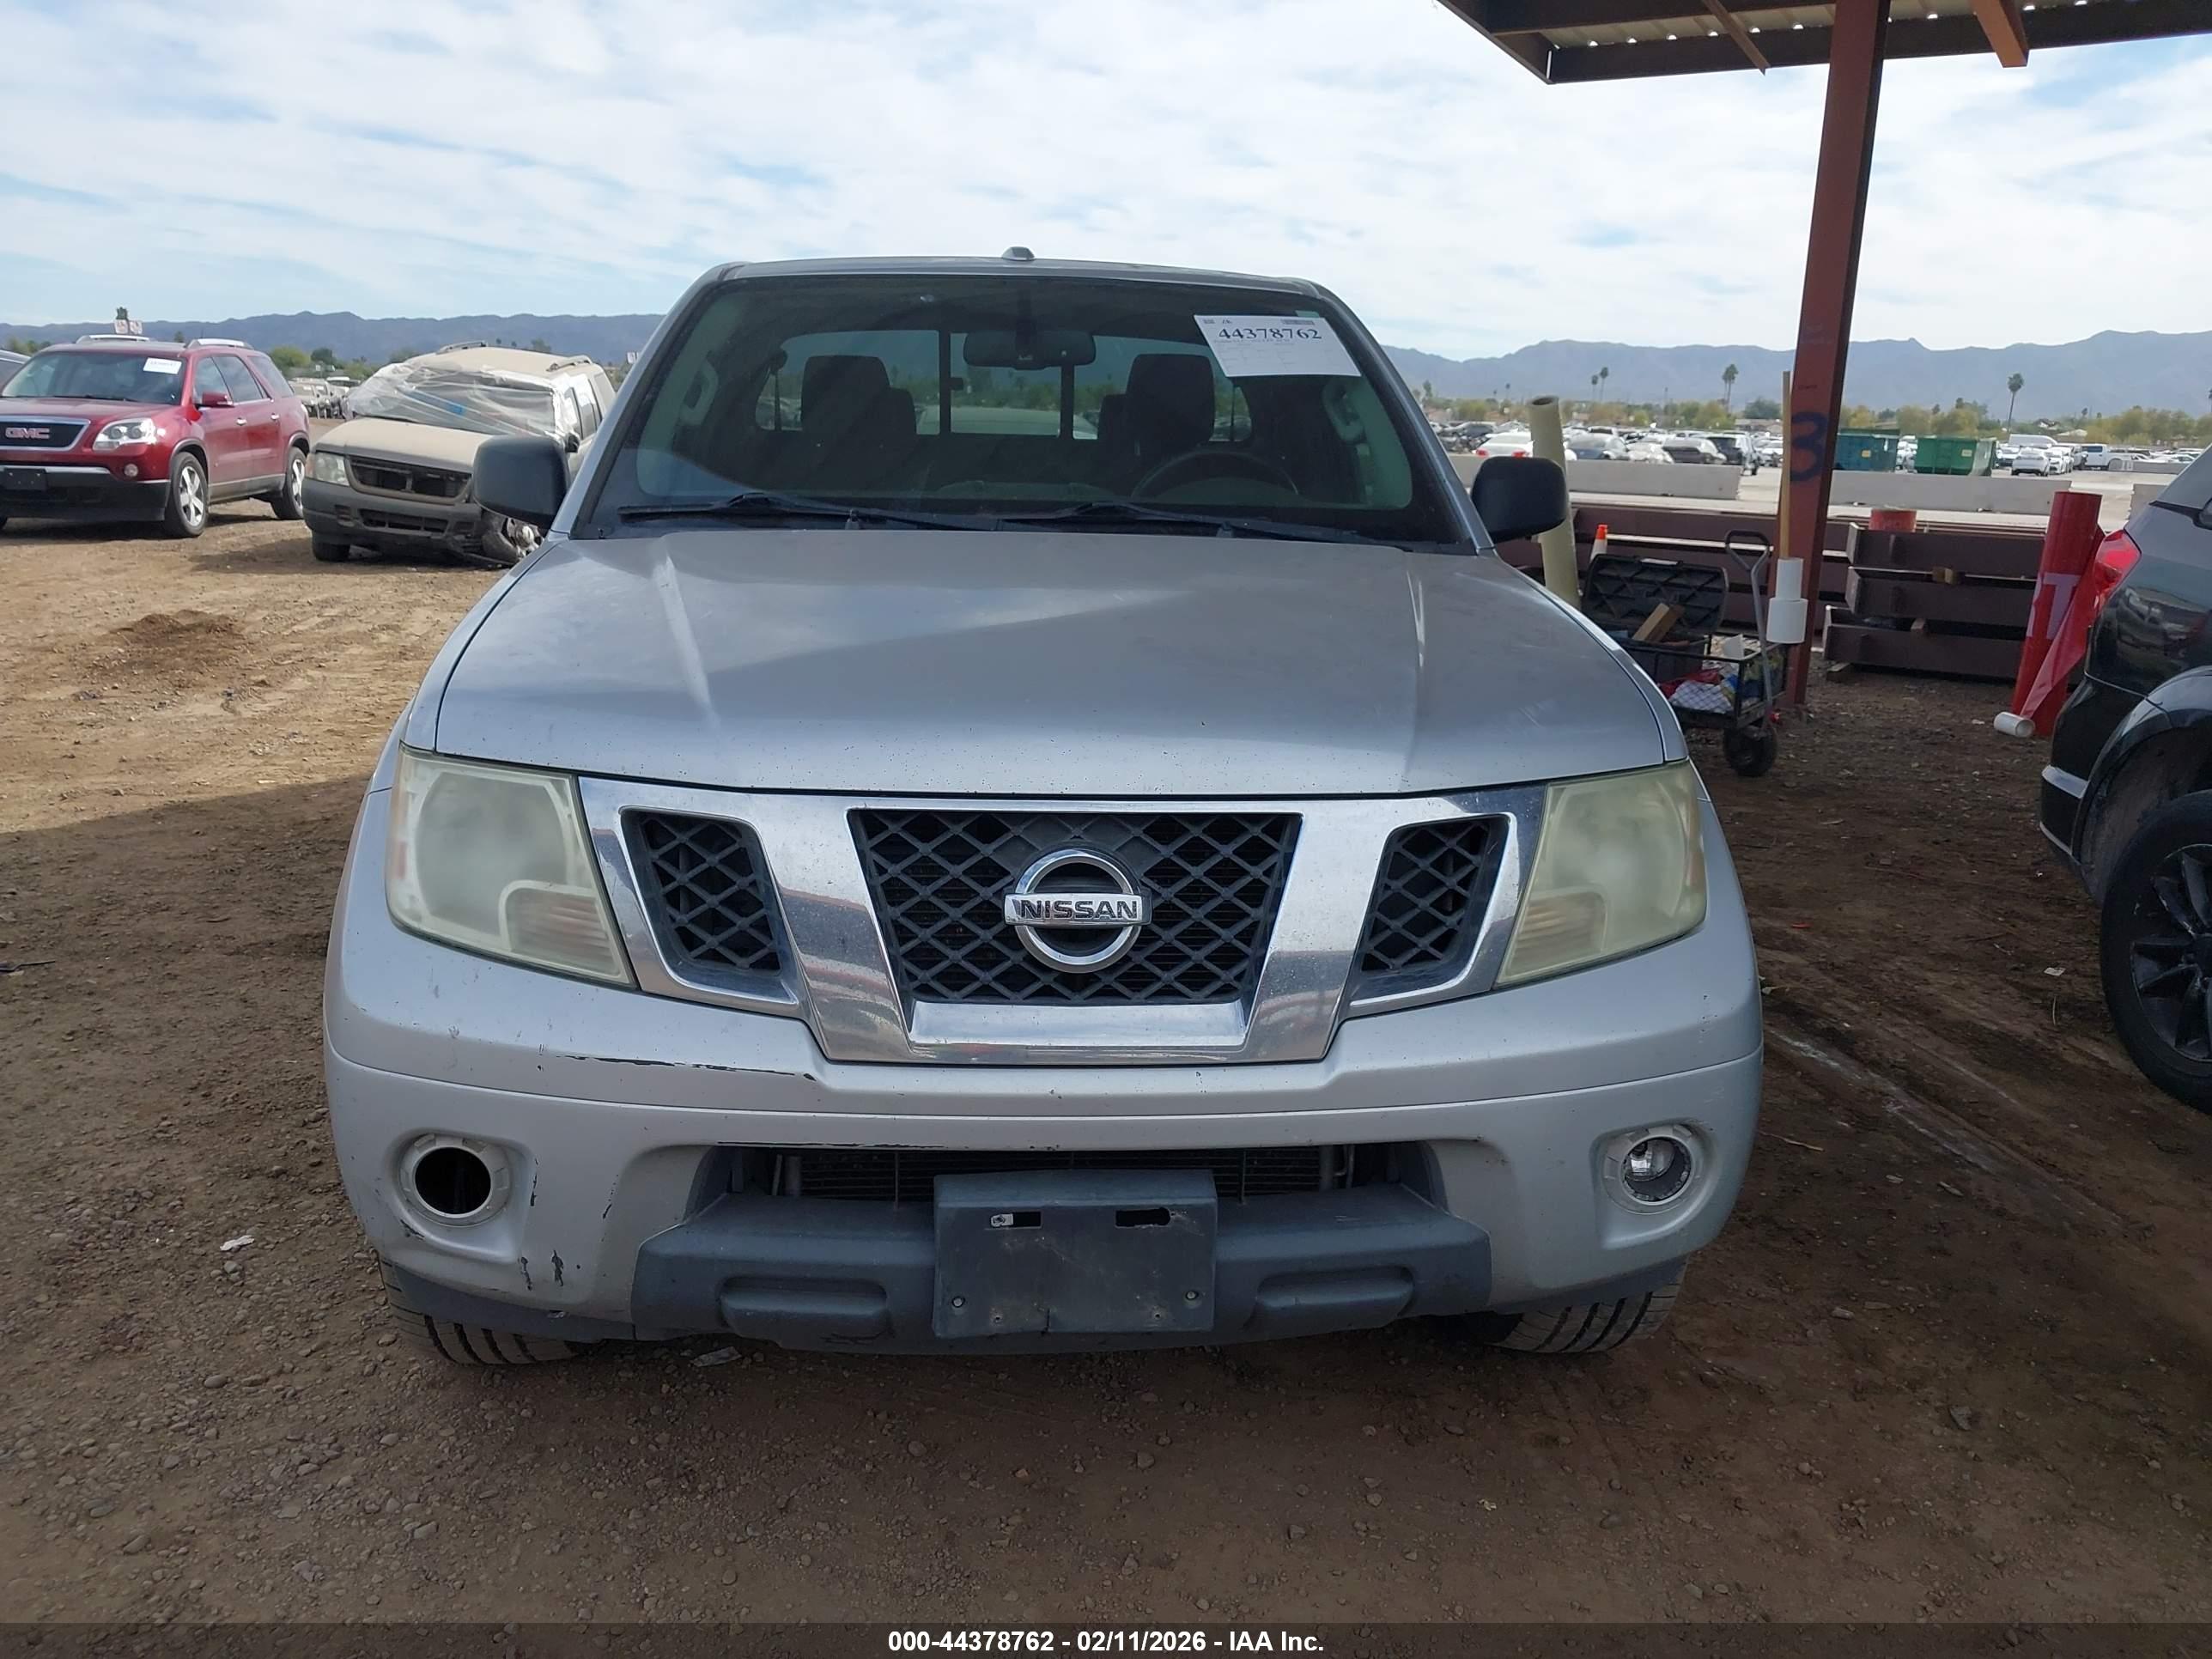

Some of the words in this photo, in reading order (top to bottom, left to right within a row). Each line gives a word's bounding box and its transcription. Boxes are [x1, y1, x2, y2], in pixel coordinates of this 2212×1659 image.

[1218, 328, 1322, 340] 44378762
[5, 427, 50, 440] GMC
[1790, 410, 1828, 483] 3
[1020, 899, 1138, 920] NISSAN
